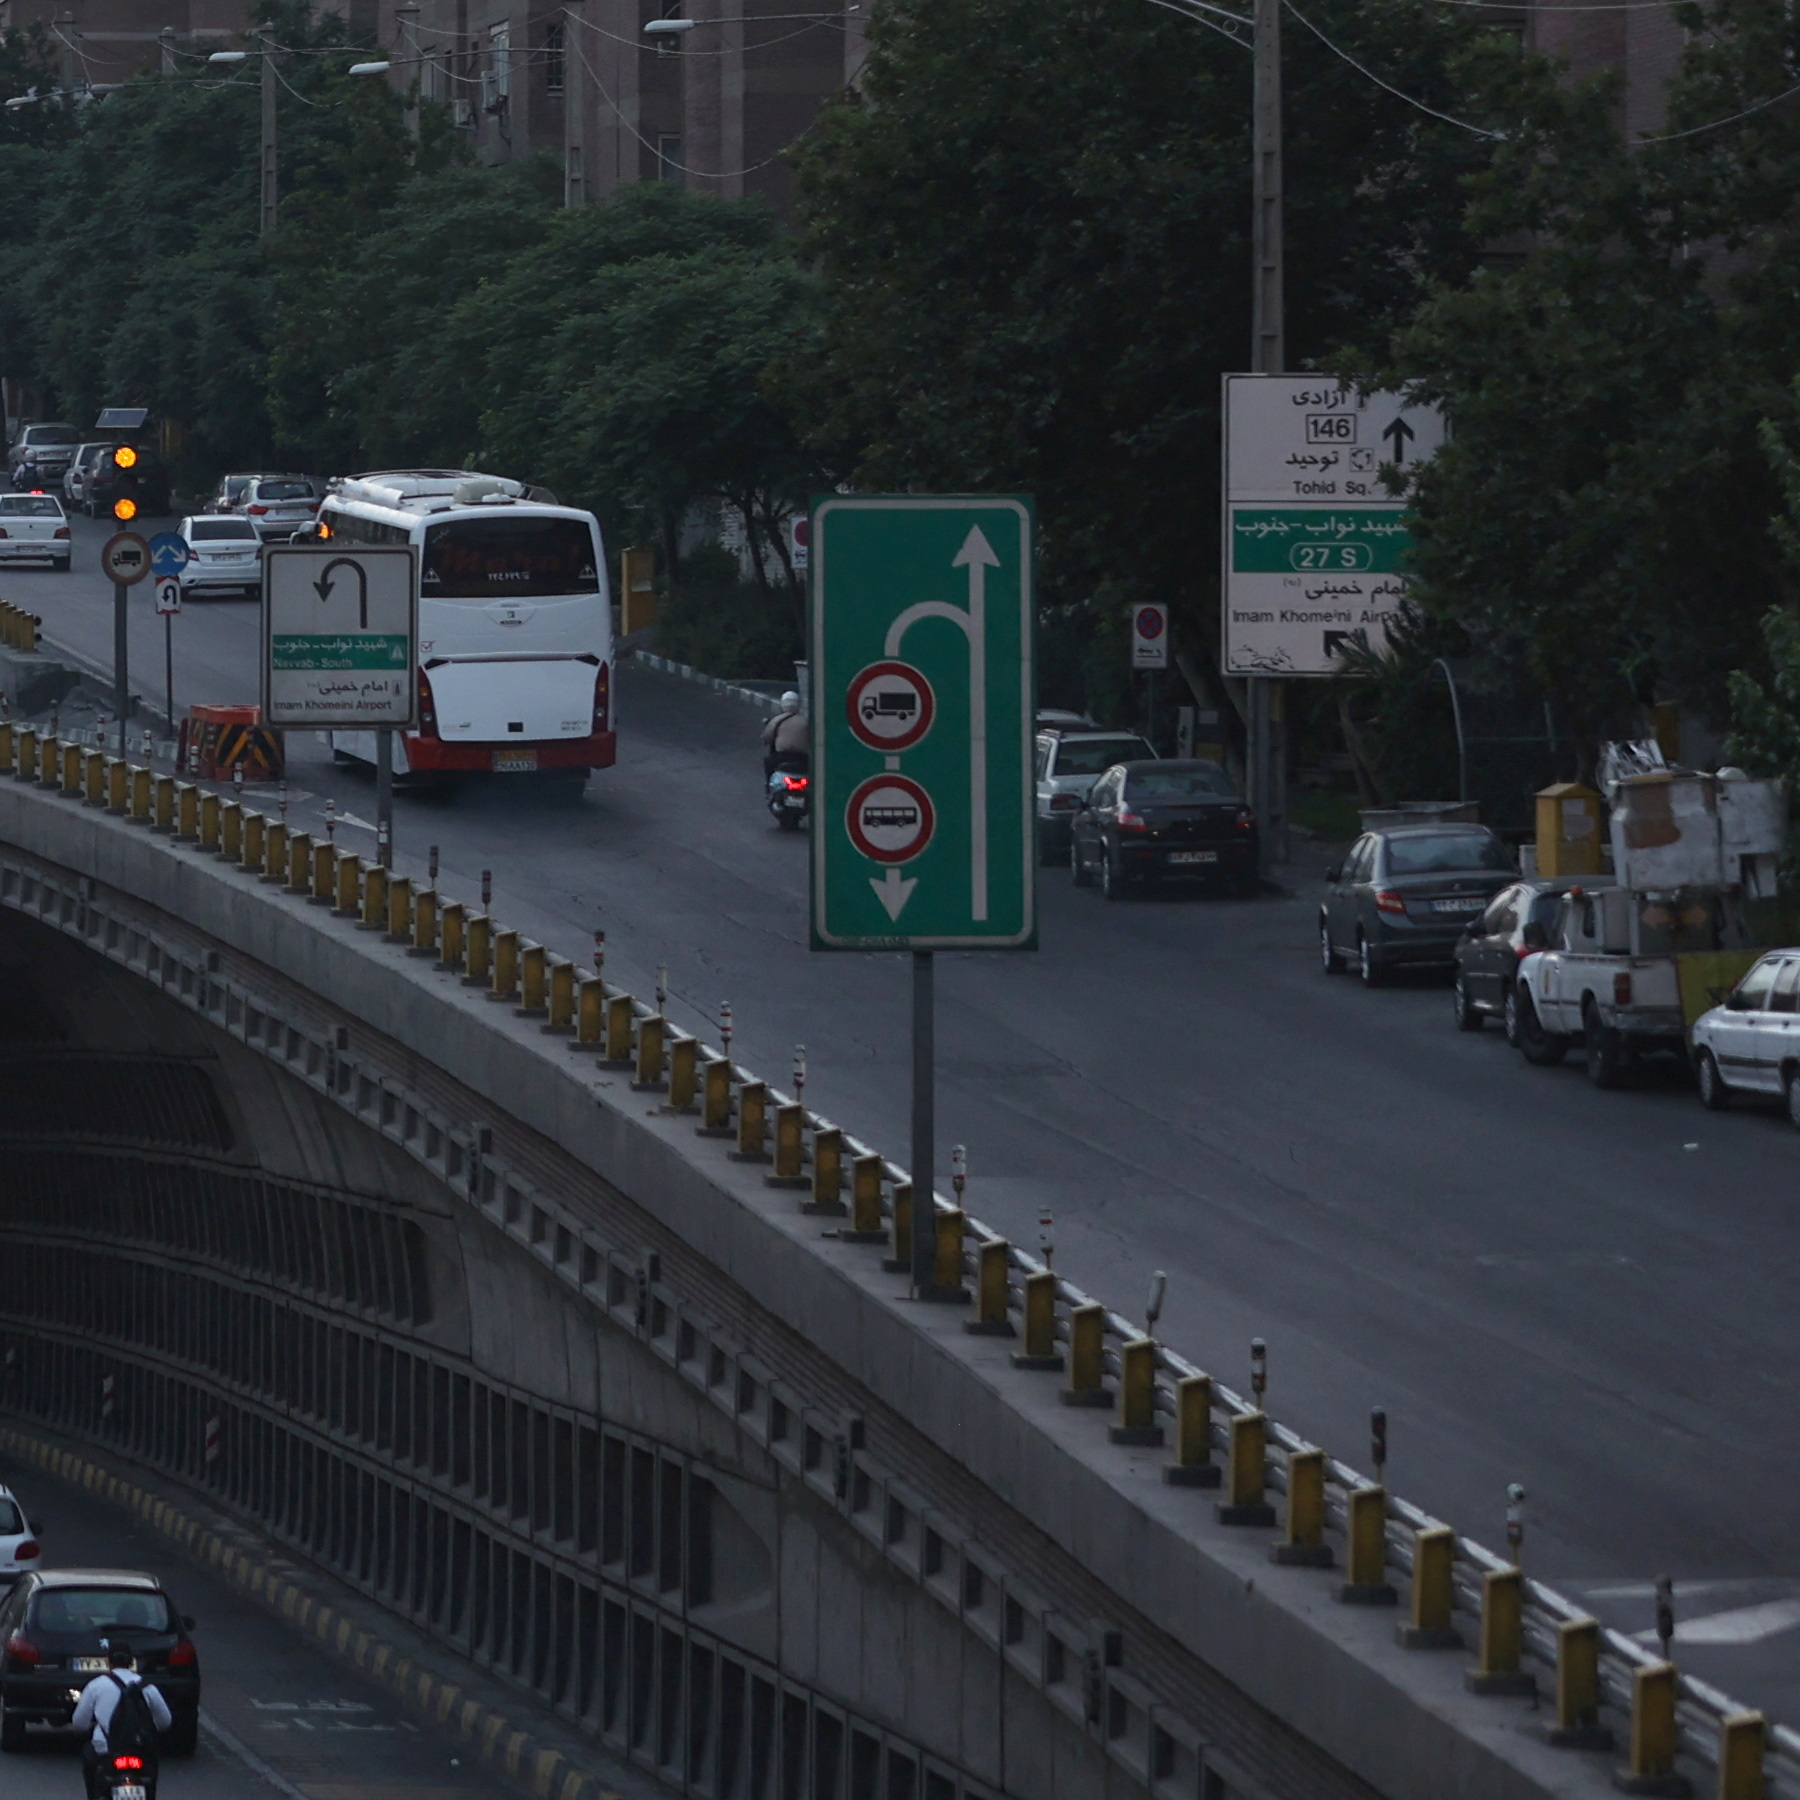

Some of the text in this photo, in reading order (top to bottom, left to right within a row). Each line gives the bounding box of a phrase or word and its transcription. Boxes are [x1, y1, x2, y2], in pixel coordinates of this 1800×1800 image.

[1311, 418, 1350, 438] 146
[1285, 450, 1340, 472] توحید
[1293, 481, 1372, 496] Tohid Sq.
[1236, 516, 1290, 538] جنوب
[1305, 516, 1357, 539] نواب
[1300, 548, 1357, 567] 27 S
[1305, 580, 1362, 600] خمینی
[1233, 610, 1274, 623] Imam
[355, 637, 387, 650] شهید
[319, 680, 358, 695] خمینی
[361, 680, 388, 696] امام
[274, 700, 392, 711] Imam Khomeini Airport
